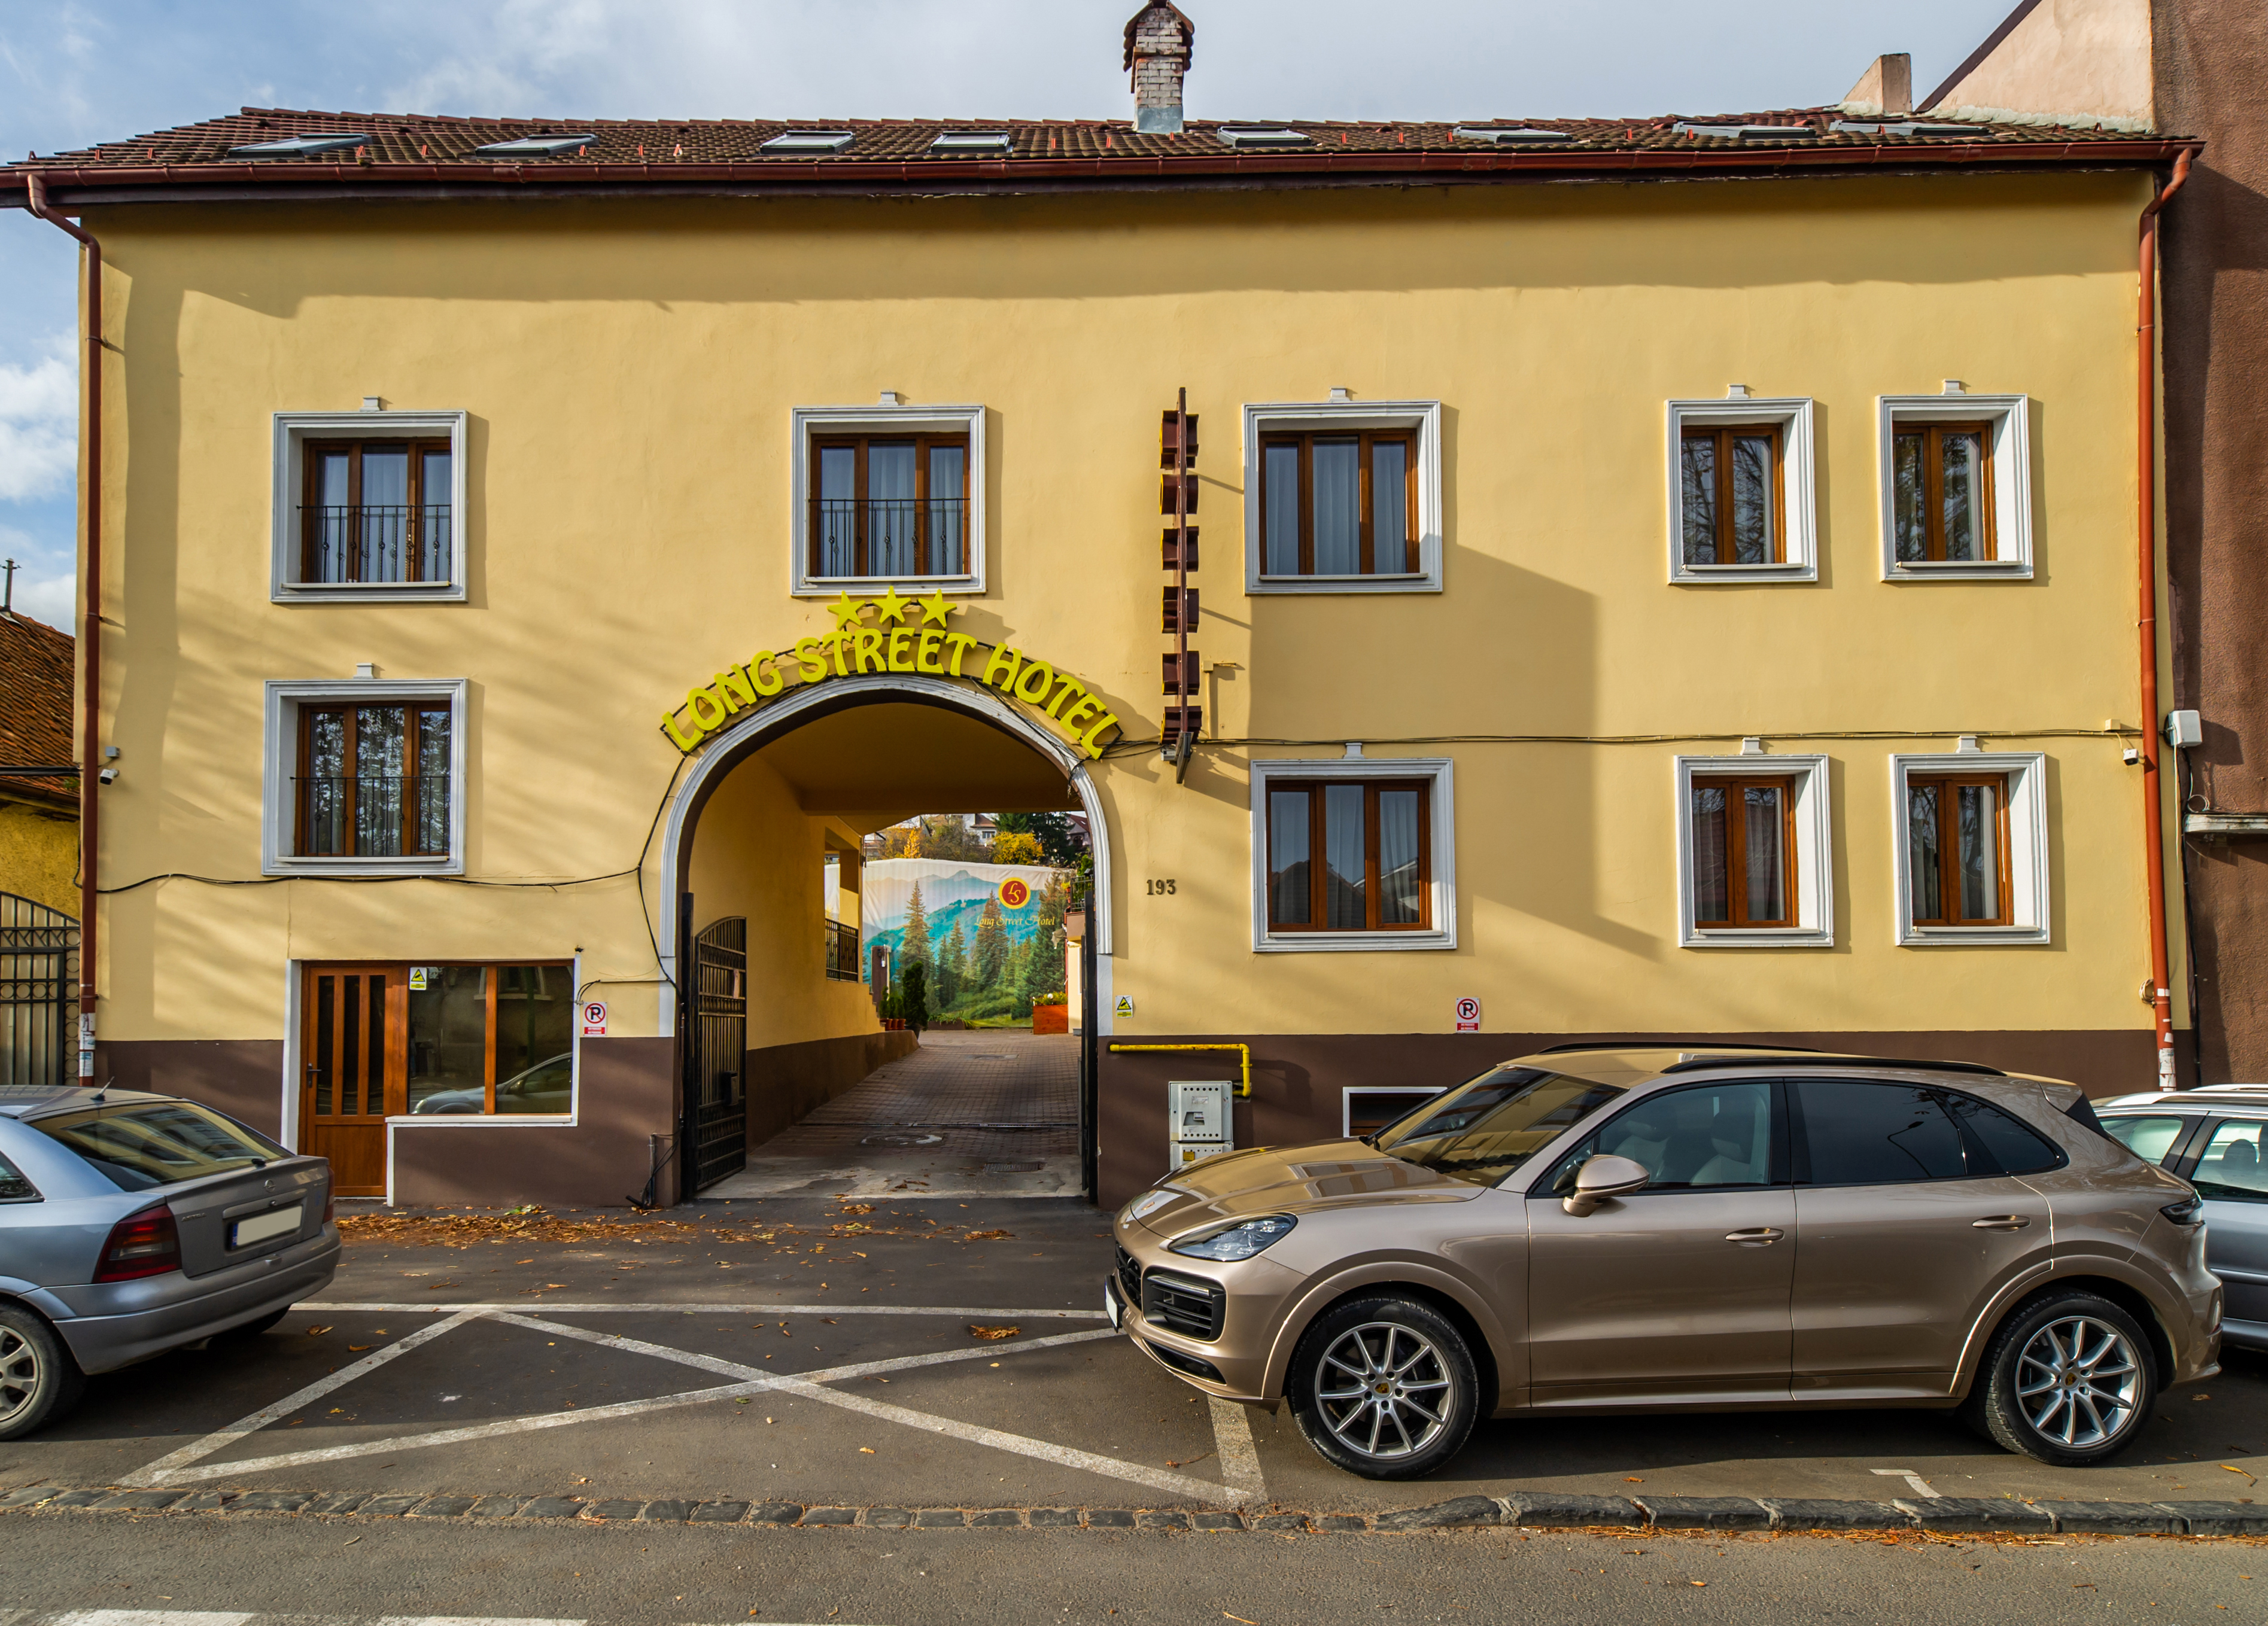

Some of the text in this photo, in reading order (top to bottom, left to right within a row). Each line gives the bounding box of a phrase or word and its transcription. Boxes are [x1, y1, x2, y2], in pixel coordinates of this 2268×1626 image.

[662, 627, 1119, 760] LONG STREET HOTEL
[1147, 879, 1176, 896] 193
[974, 914, 1055, 928] Long Street Hotel
[591, 1007, 601, 1020] P
[1463, 1002, 1473, 1016] P
